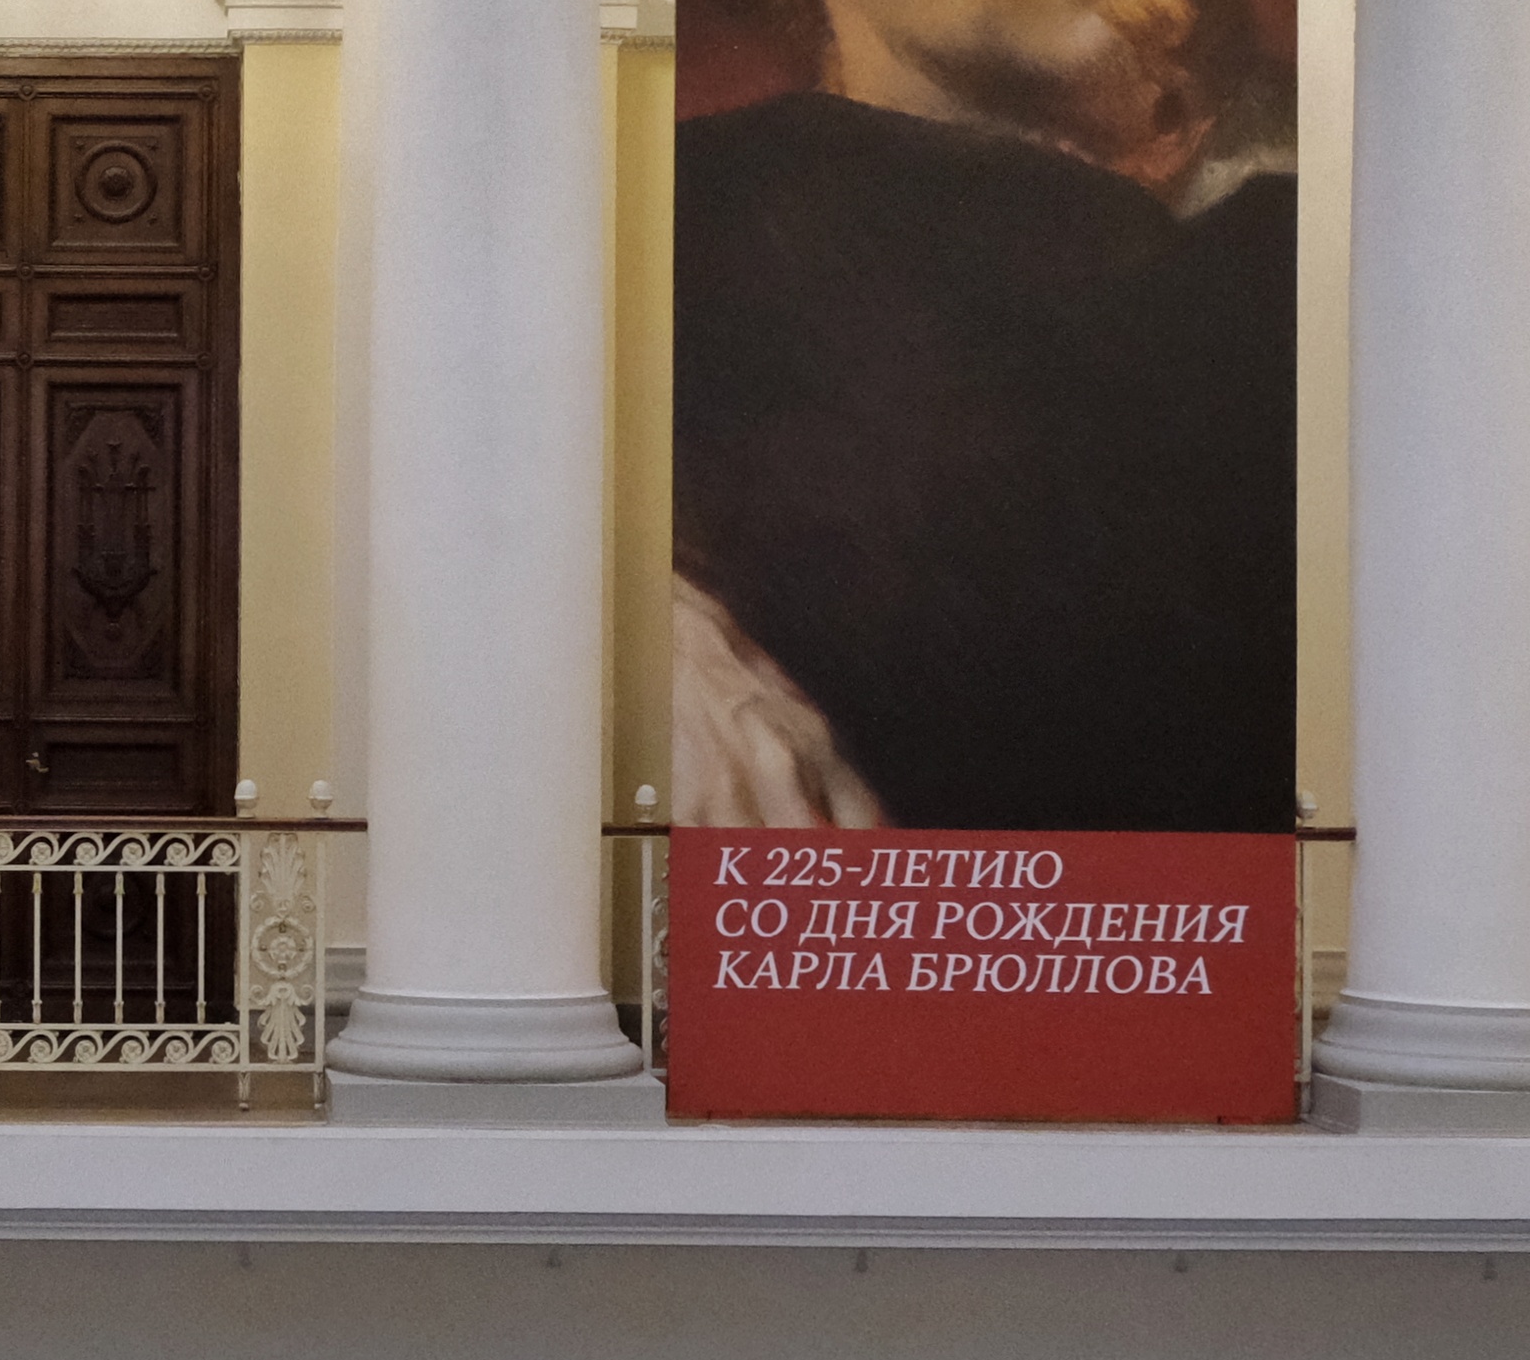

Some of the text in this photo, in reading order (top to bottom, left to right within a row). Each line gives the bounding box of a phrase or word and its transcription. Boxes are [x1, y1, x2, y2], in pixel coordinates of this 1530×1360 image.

[713, 846, 1064, 890] К 225-ЛЕТИЮ
[715, 899, 1249, 950] СО ДНЯ РОЖДЕНИЯ
[713, 950, 1214, 996] КАРЛА БРЮЛЛОВА
